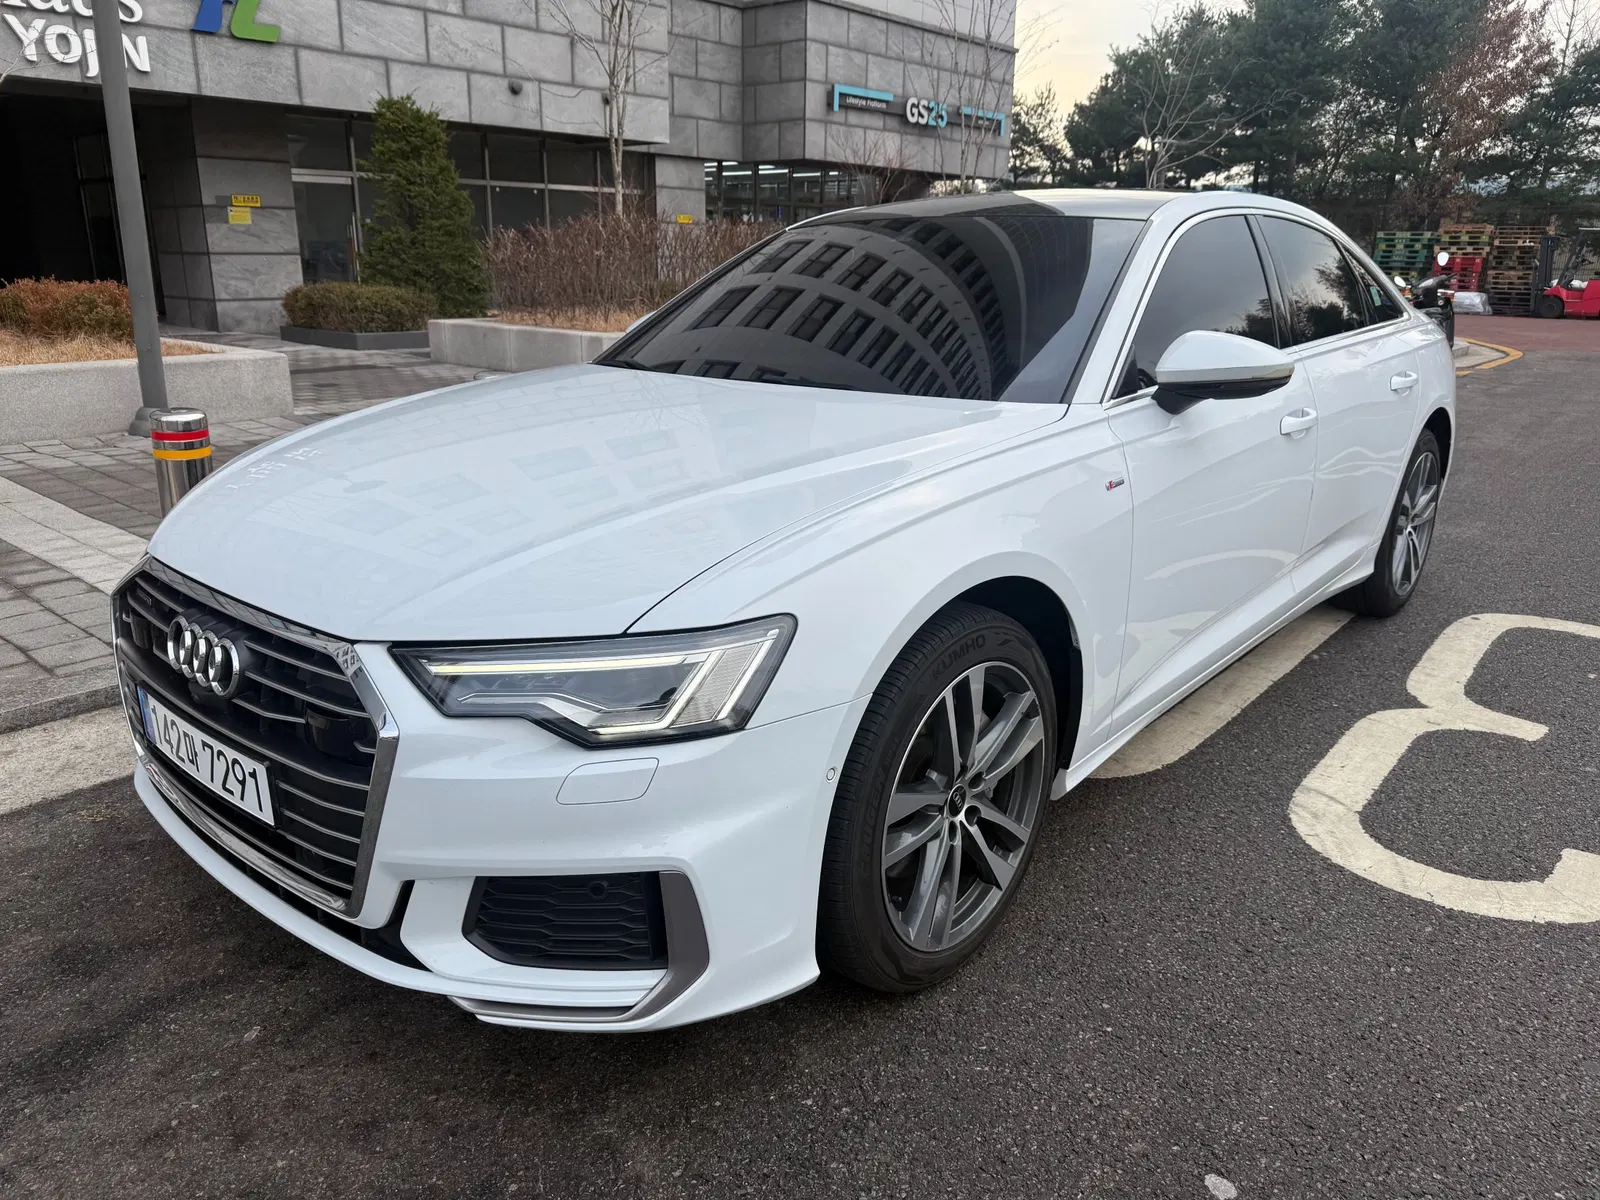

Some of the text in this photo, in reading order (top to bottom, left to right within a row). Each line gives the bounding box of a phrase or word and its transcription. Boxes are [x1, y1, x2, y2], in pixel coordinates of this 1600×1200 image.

[2, 13, 151, 77] YOJN
[905, 96, 948, 128] GS25
[931, 633, 986, 681] KUMHO
[201, 738, 264, 813] 7291
